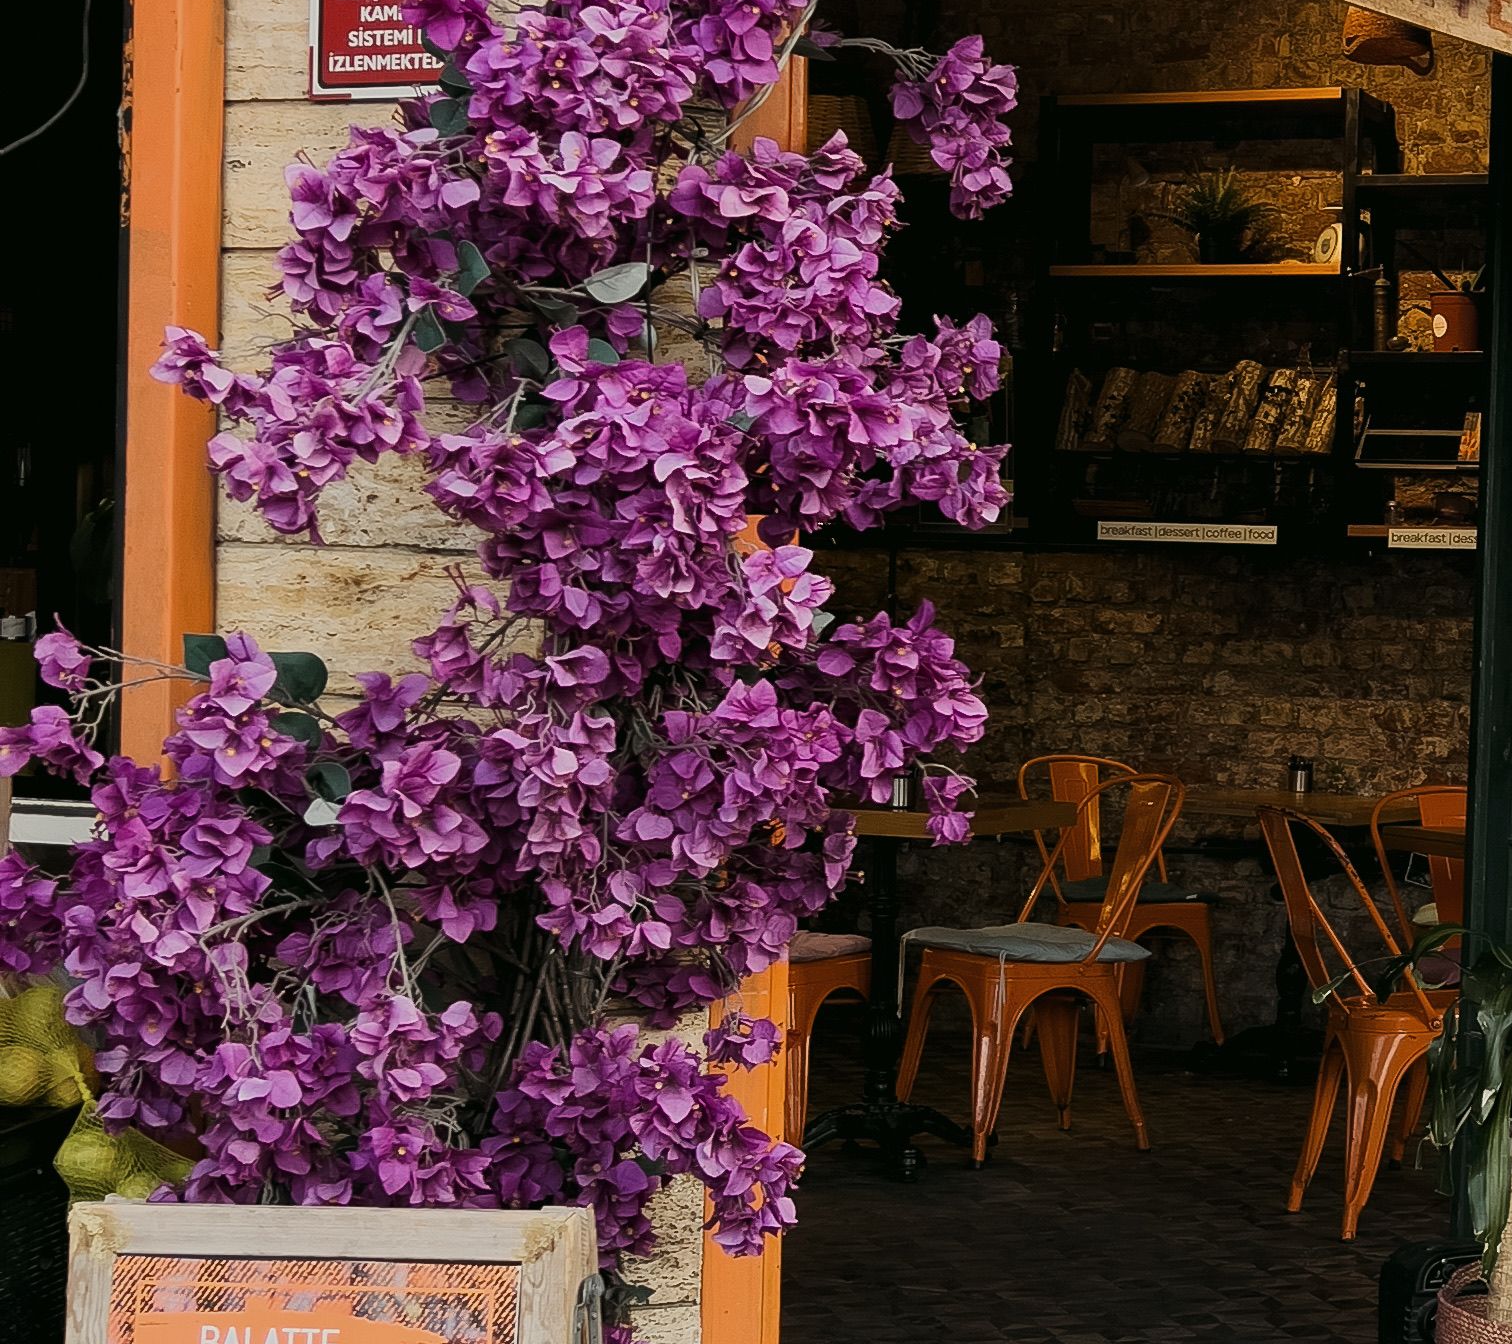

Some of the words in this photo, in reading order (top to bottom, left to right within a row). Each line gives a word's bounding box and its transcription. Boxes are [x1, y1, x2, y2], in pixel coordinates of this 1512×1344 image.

[348, 25, 413, 47] SİSTEMİ
[1100, 524, 1153, 537] breakfast
[1158, 526, 1200, 538] dessert
[1206, 527, 1242, 539] coffee
[1248, 528, 1275, 540] food
[1391, 532, 1446, 543] breakfast
